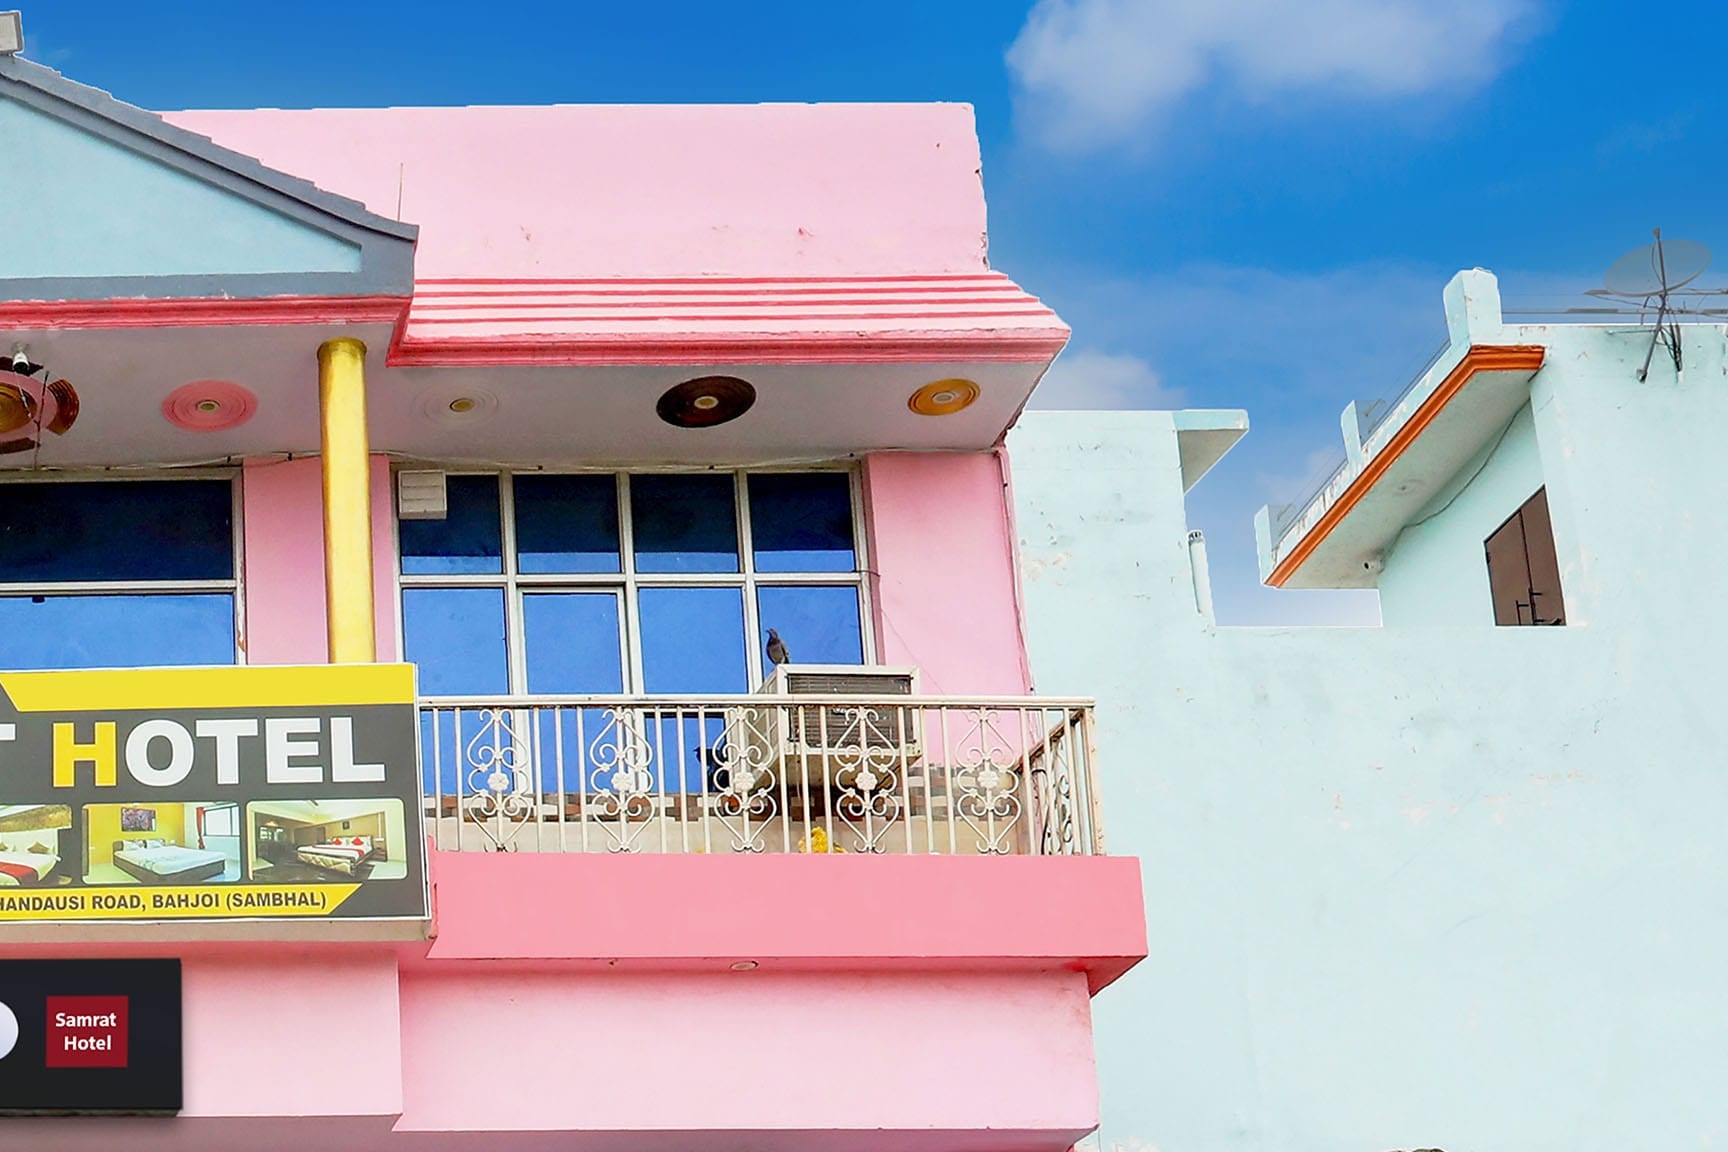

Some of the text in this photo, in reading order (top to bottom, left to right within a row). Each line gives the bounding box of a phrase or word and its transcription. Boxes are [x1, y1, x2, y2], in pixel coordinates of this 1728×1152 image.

[52, 717, 386, 787] HOTEL
[92, 894, 146, 911] ROAD,
[153, 893, 219, 909] BAHJOI
[226, 891, 326, 910] (SAMBHAL)
[55, 1012, 117, 1028] Samrat
[64, 1035, 112, 1051] Hotel
